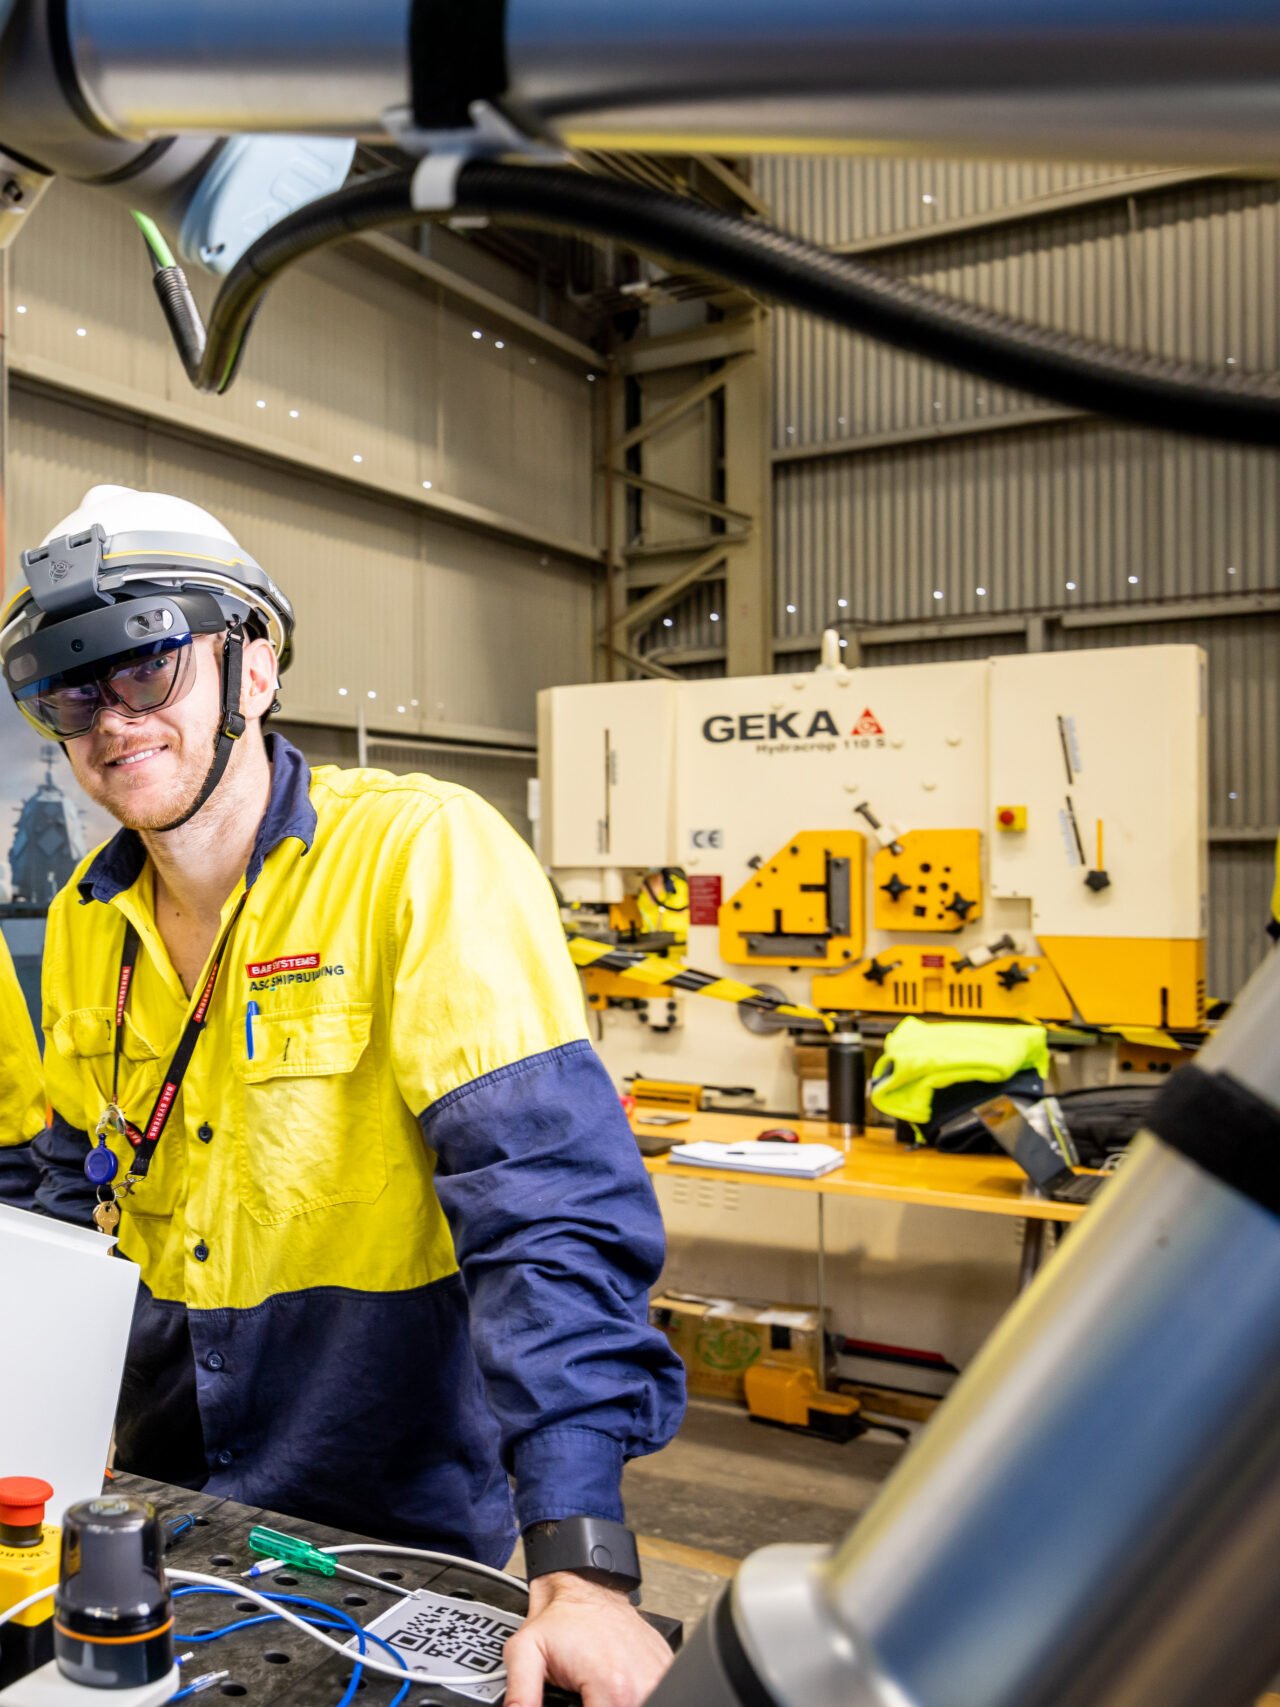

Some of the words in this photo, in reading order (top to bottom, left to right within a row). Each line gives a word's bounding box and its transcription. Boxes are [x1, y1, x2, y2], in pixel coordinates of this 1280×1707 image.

[702, 710, 840, 743] GEKA
[756, 741, 837, 755] Hydracrop
[844, 738, 870, 749] 110
[693, 829, 719, 849] CE
[251, 963, 272, 975] BAE
[118, 967, 131, 1005] SYSTEMS
[149, 1102, 168, 1137] SYSTEMS
